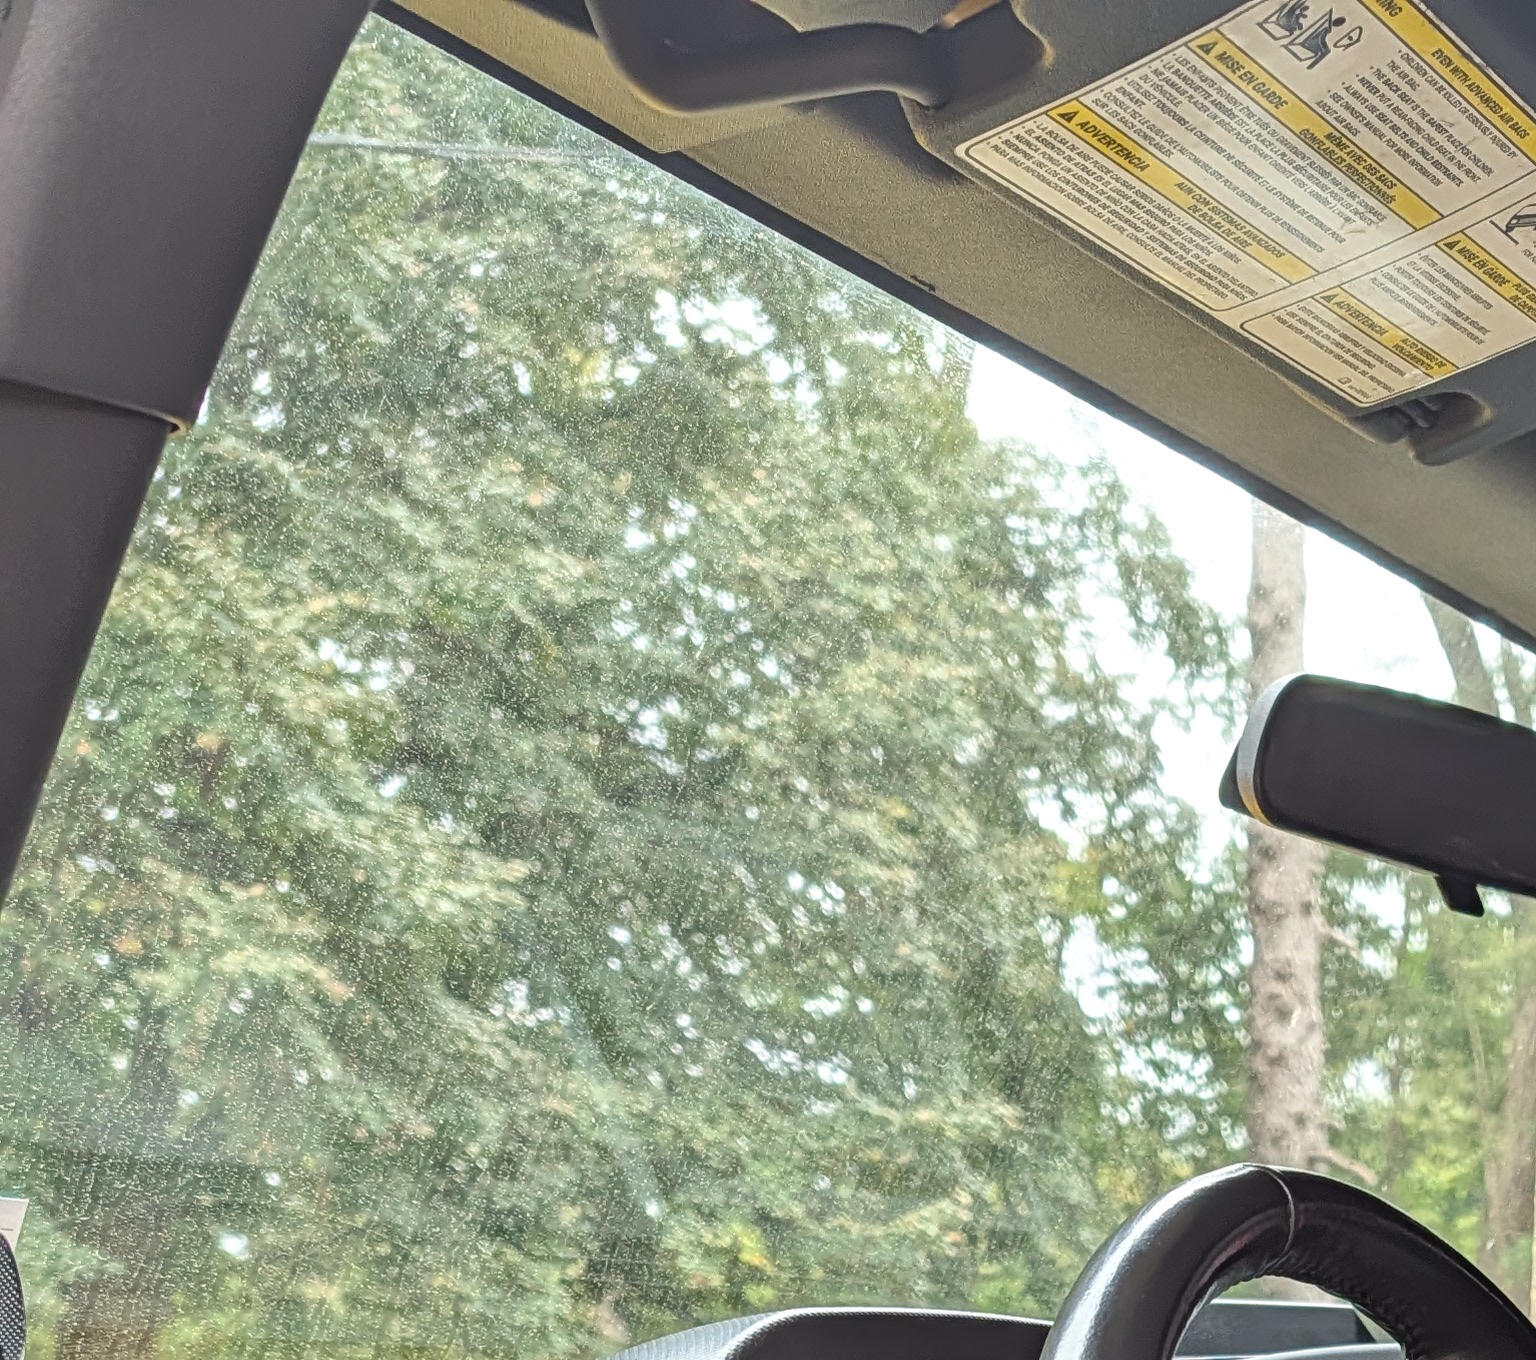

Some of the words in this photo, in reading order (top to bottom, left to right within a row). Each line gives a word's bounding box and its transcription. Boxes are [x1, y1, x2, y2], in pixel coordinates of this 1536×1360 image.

[1428, 47, 1457, 69] EVEN
[1210, 50, 1247, 75] MISE
[1235, 69, 1260, 85] EN
[1249, 80, 1291, 110] GARDE
[1367, 67, 1388, 81] THE
[1446, 64, 1474, 85] WITH
[1378, 77, 1403, 95] BACK
[1394, 90, 1417, 107] SEAT
[1408, 103, 1423, 112] IS
[1463, 80, 1506, 115] ADVANCED
[1341, 83, 1371, 106] ALWAYS
[1362, 101, 1381, 114] USE
[1372, 110, 1395, 126] SEAT
[1386, 122, 1411, 140] BELTS
[1402, 136, 1422, 149] AND
[1413, 145, 1437, 162] CHILD
[1413, 107, 1432, 120] THE
[1496, 110, 1517, 125] AIR
[1423, 116, 1450, 136] SAFEST
[1506, 120, 1533, 140] BAGS
[1072, 118, 1155, 172] ADVERTENCIA
[1442, 132, 1465, 149] PLACE
[1455, 144, 1475, 157] FOR
[1321, 130, 1354, 152] MÊME
[1342, 148, 1368, 166] AVEC
[1360, 162, 1381, 176] DES
[1373, 173, 1398, 190] SACS
[1171, 180, 1197, 196] AUN
[1188, 192, 1214, 208] CON
[1205, 203, 1249, 232] SISTEMAS
[1240, 227, 1288, 259] AVANZADOS
[1184, 203, 1203, 215] DE
[1195, 211, 1227, 231] BOLSA
[1219, 227, 1237, 238] DE
[1229, 234, 1254, 249] AIRE
[1453, 245, 1481, 263] MISE
[1470, 258, 1491, 271] EN
[1479, 266, 1512, 288] GARDE
[1331, 298, 1391, 337] ADVERTENCIA
